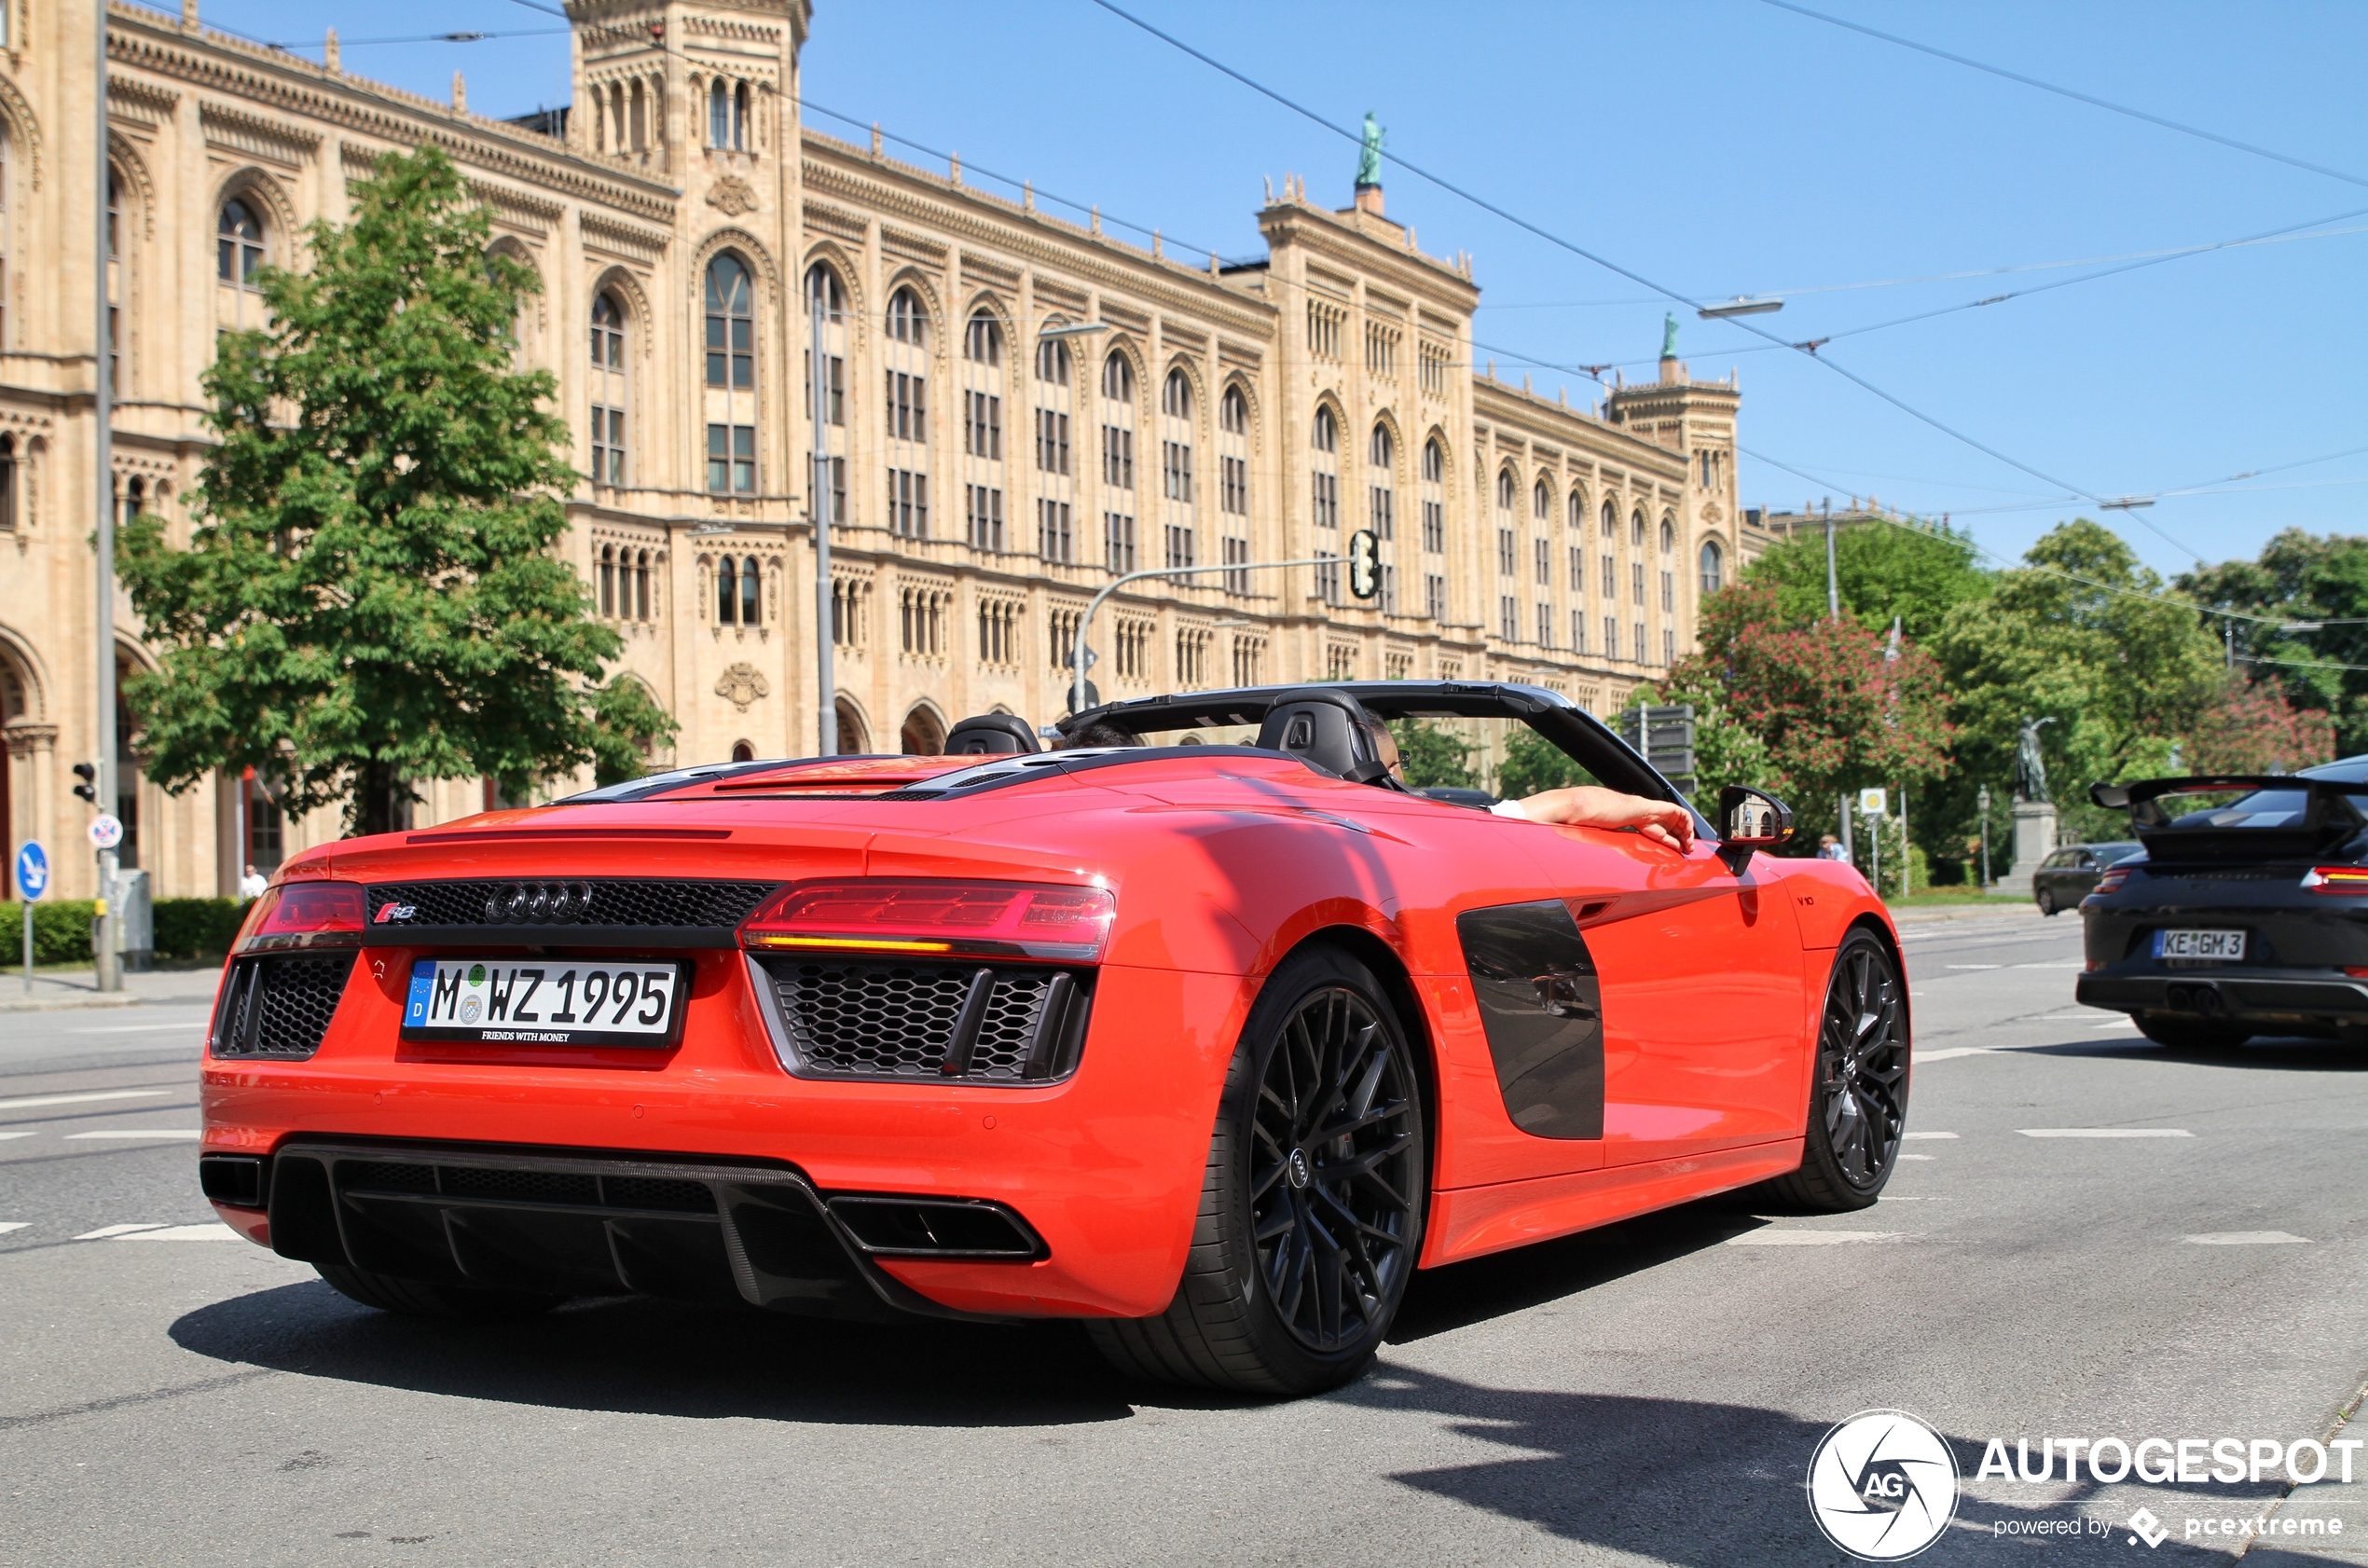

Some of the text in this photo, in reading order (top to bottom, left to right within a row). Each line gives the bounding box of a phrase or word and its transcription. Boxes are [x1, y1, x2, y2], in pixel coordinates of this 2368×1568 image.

[1797, 897, 1814, 906] V10
[2165, 933, 2242, 955] KE GM 3
[432, 969, 462, 1020] M
[489, 969, 545, 1022] WZ
[551, 970, 669, 1025] 1995
[413, 1003, 423, 1017] D
[481, 1031, 570, 1042] FRIENDS WITH MONEY
